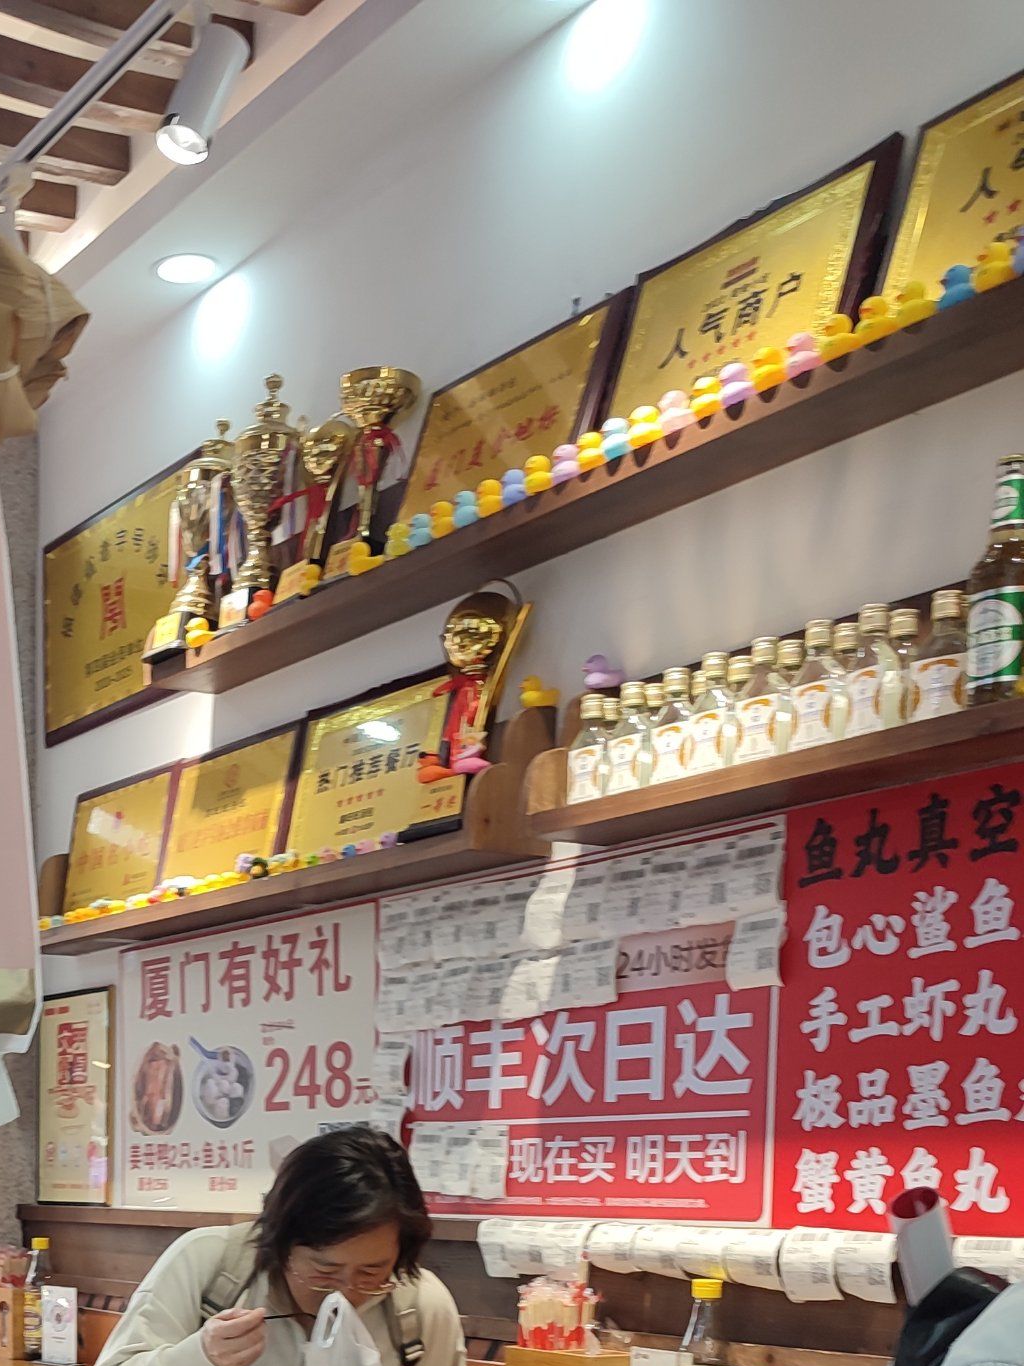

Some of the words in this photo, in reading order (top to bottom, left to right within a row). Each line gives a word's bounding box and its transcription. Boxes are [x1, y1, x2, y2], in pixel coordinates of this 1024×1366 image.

[658, 271, 805, 370] 人气商户
[798, 784, 1021, 888] 鱼丸真空
[139, 922, 352, 1021] 厦门有好礼
[616, 937, 733, 980] 24小时发
[800, 969, 1018, 1052] 手工虾丸
[407, 993, 753, 1112] 顺丰次日达
[792, 1058, 1024, 1131] 极品墨鱼
[510, 1135, 616, 1184] 现在买
[626, 1130, 747, 1184] 明天到
[791, 1147, 1010, 1215] 蟹黄鱼丸
